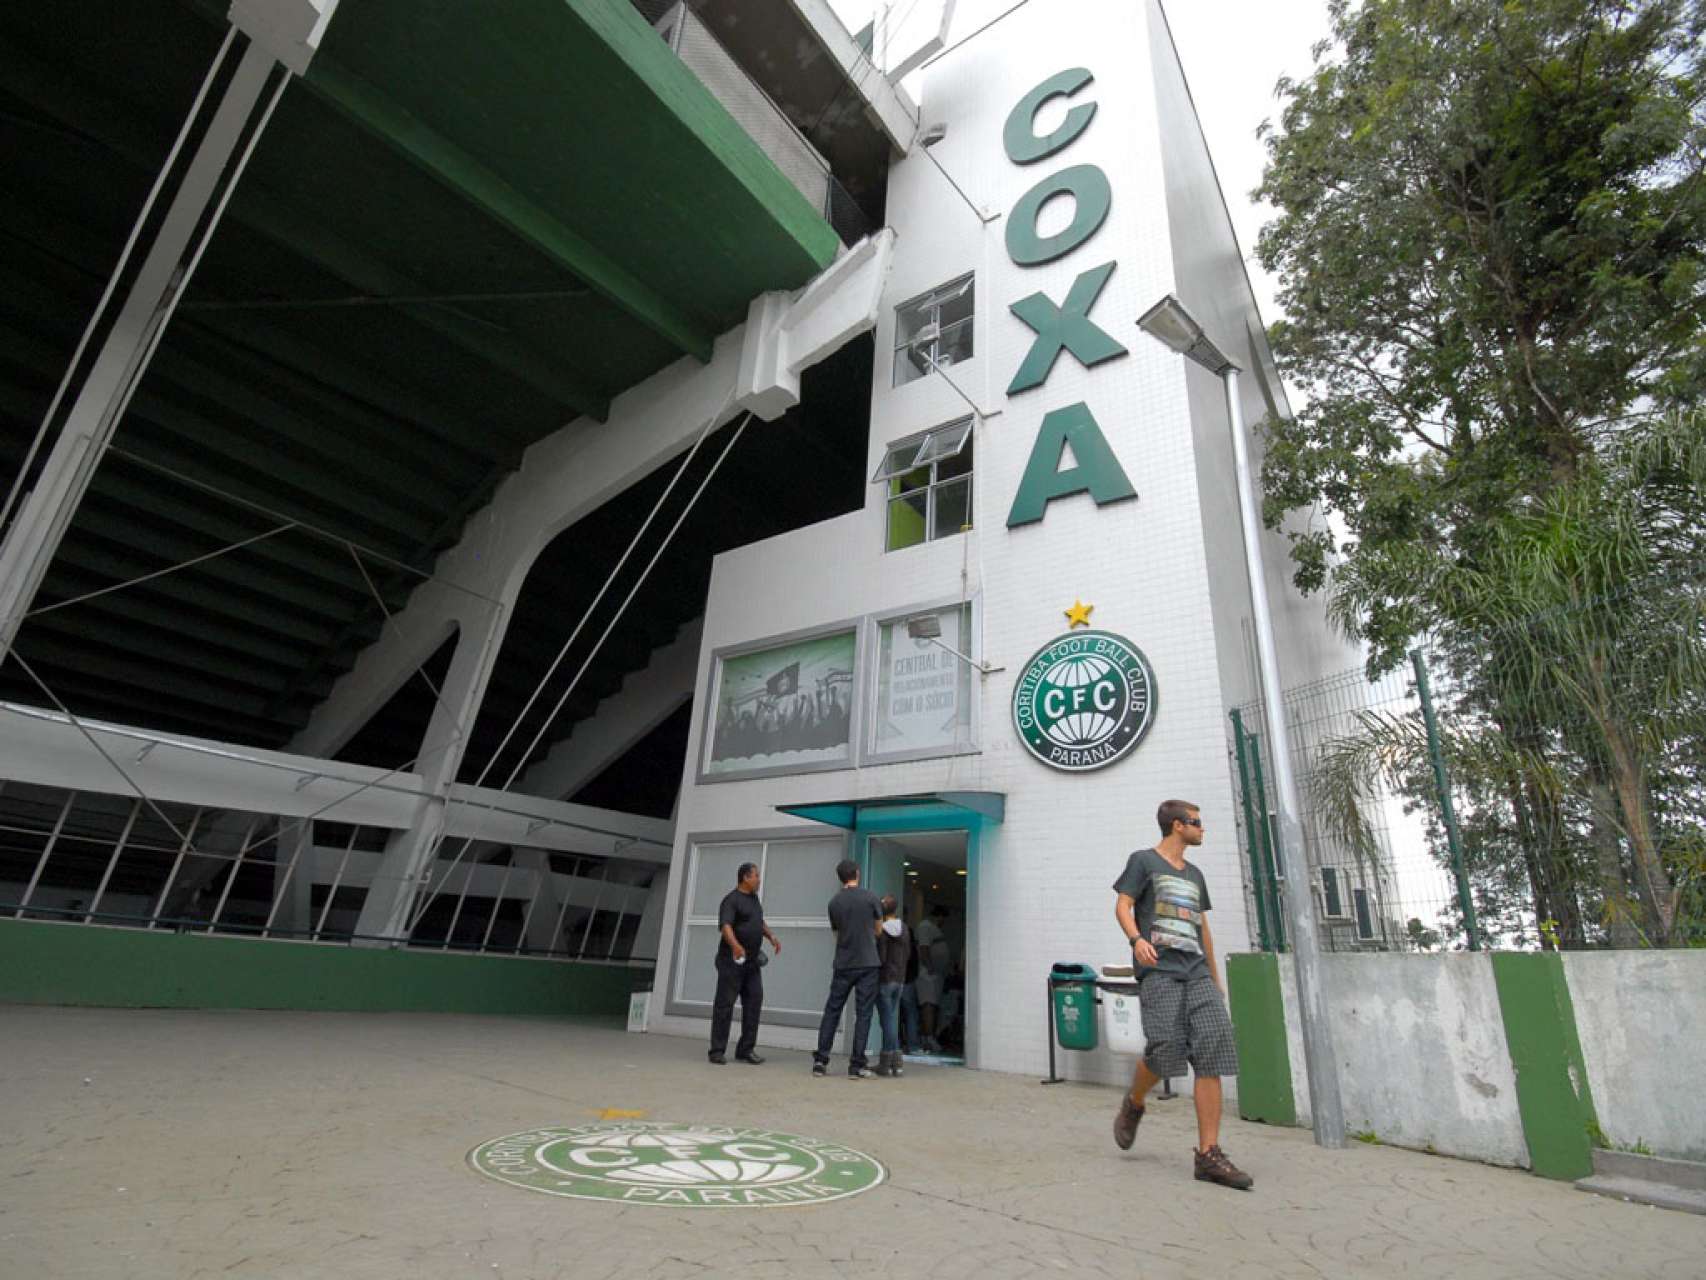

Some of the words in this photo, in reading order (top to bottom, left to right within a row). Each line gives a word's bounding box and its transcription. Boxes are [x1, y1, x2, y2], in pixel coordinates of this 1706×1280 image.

[1002, 66, 1138, 530] COXA
[894, 652, 937, 676] CENTRAL
[1018, 661, 1049, 729] CORITIBA
[1050, 639, 1089, 661] FOOT
[1095, 639, 1131, 669] BALL
[1127, 667, 1146, 713] CLUB
[1044, 680, 1116, 719] CFC
[568, 1143, 792, 1168] CFC
